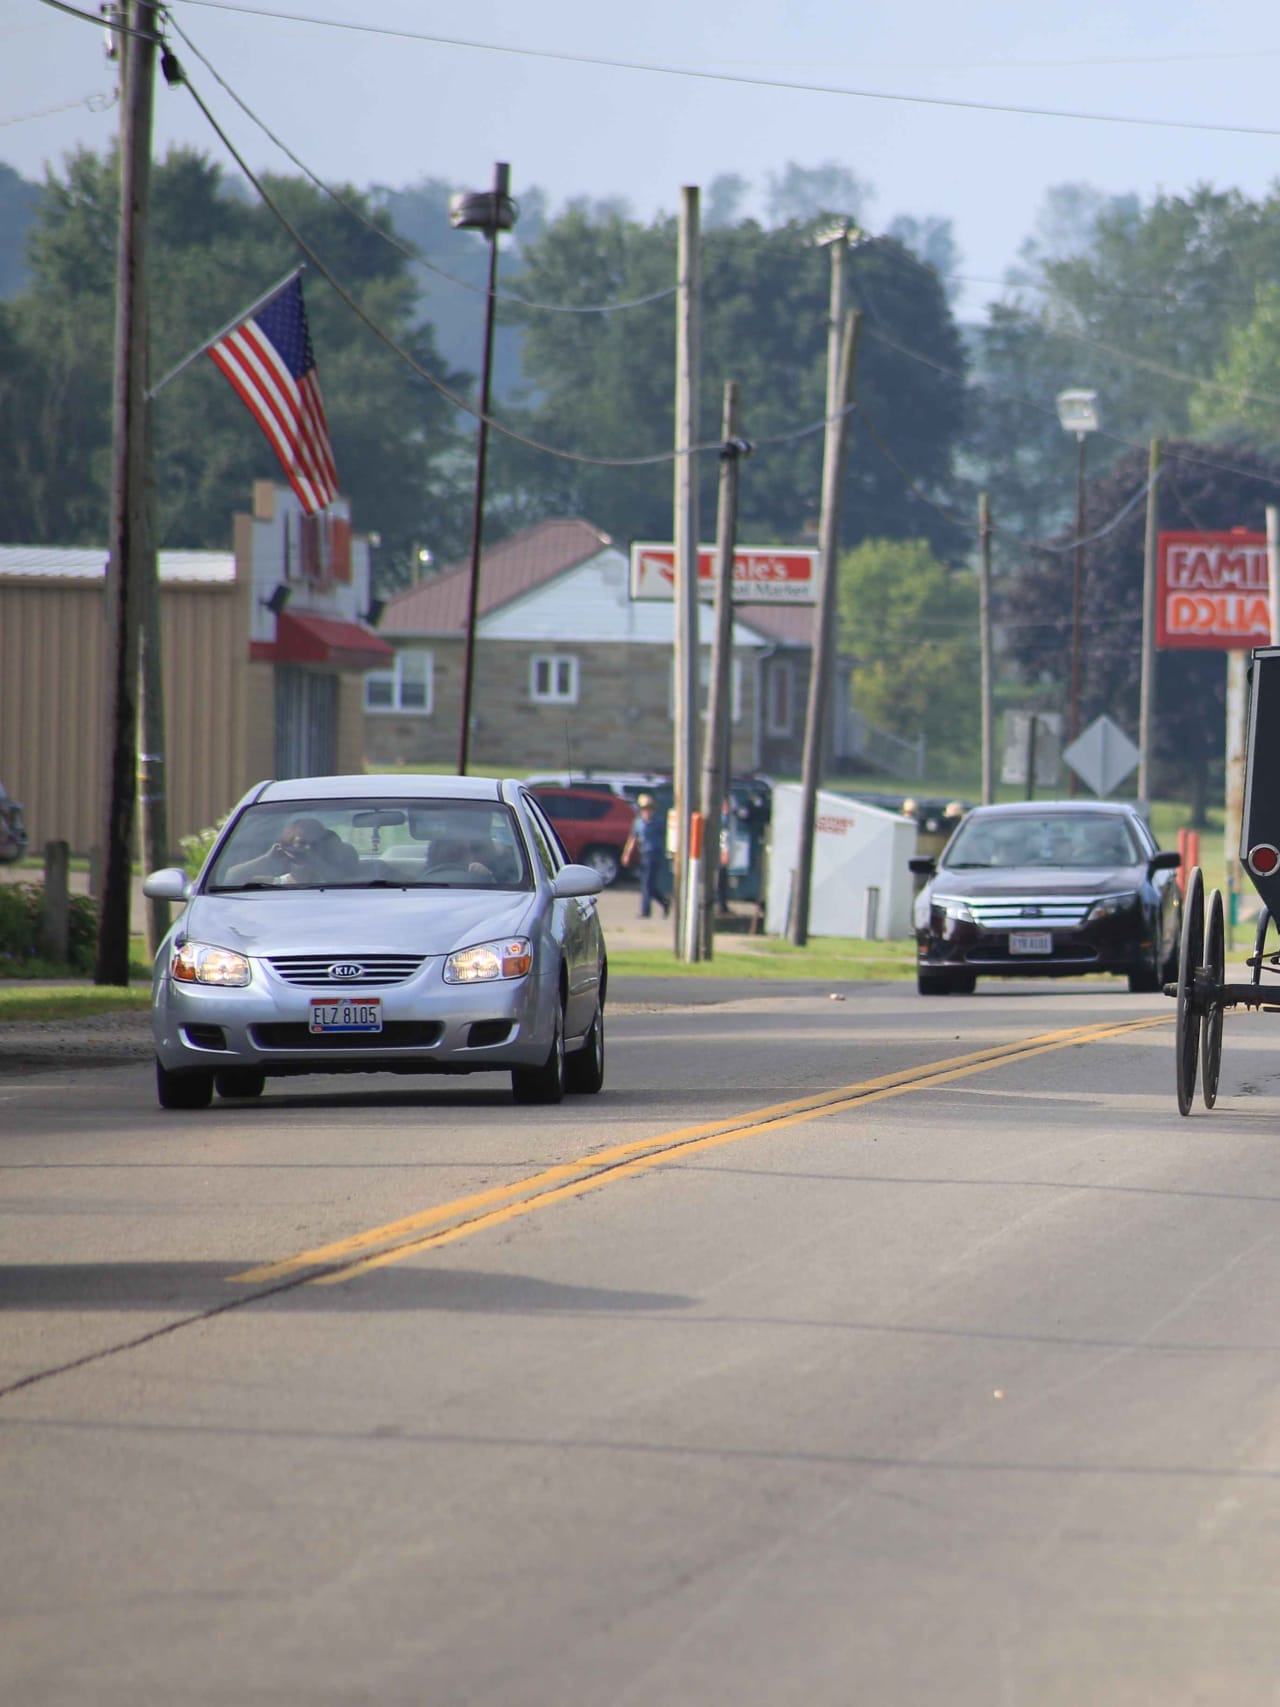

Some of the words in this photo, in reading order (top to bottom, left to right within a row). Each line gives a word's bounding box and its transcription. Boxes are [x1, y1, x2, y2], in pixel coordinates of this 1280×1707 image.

[335, 966, 356, 975] KIA
[314, 1008, 338, 1025] ELZ
[343, 1007, 377, 1025] 8105
